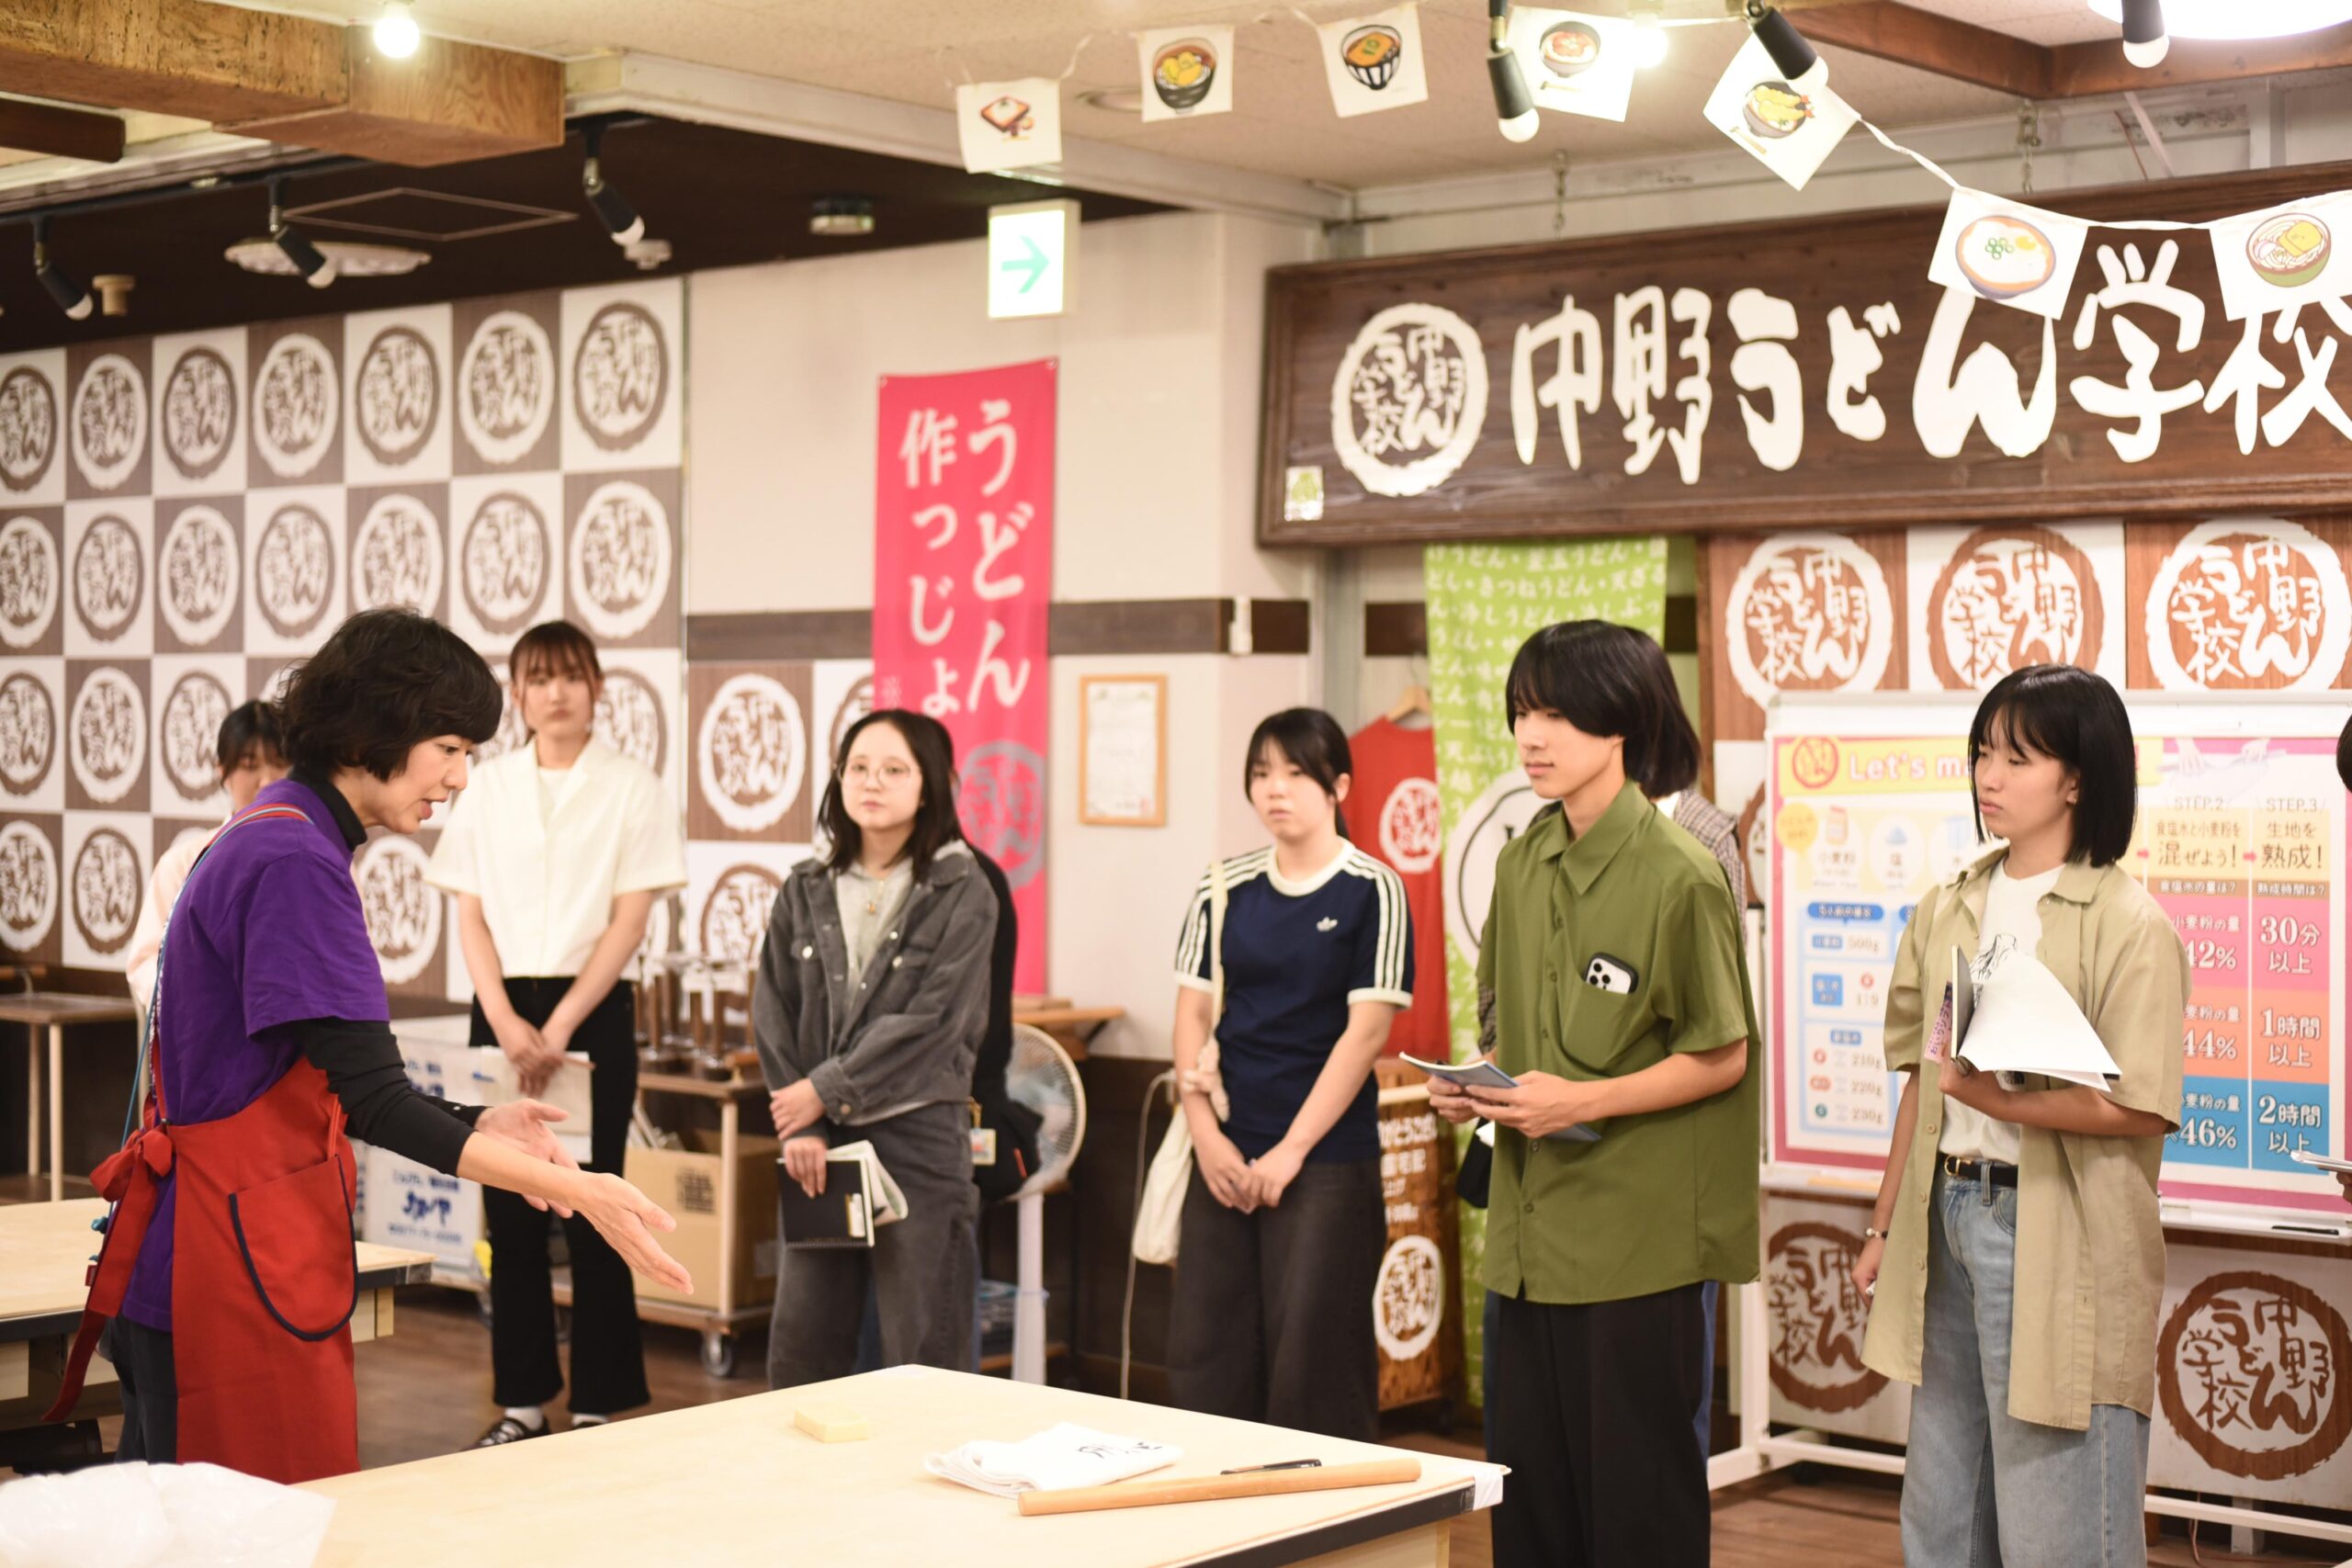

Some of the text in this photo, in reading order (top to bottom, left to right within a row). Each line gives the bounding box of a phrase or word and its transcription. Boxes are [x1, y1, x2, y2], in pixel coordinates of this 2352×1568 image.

[1511, 239, 2352, 483] 中野うどん学校
[967, 399, 1035, 713] うどん
[1849, 750, 1927, 781] Let's
[2174, 795, 2224, 813] STEP.2
[2266, 796, 2318, 813] STEP.3
[2267, 820, 2316, 840] 生地を
[2260, 915, 2322, 948] 30分
[2268, 950, 2312, 976] 以上
[2184, 1004, 2242, 1022] 麦粉の量
[2260, 1008, 2321, 1040] 1時間
[2267, 1043, 2312, 1068] 以上
[2181, 1093, 2242, 1113] 麦粉の量
[2258, 1094, 2322, 1129] 2時間
[2182, 1294, 2330, 1434] 中野うどん学校
